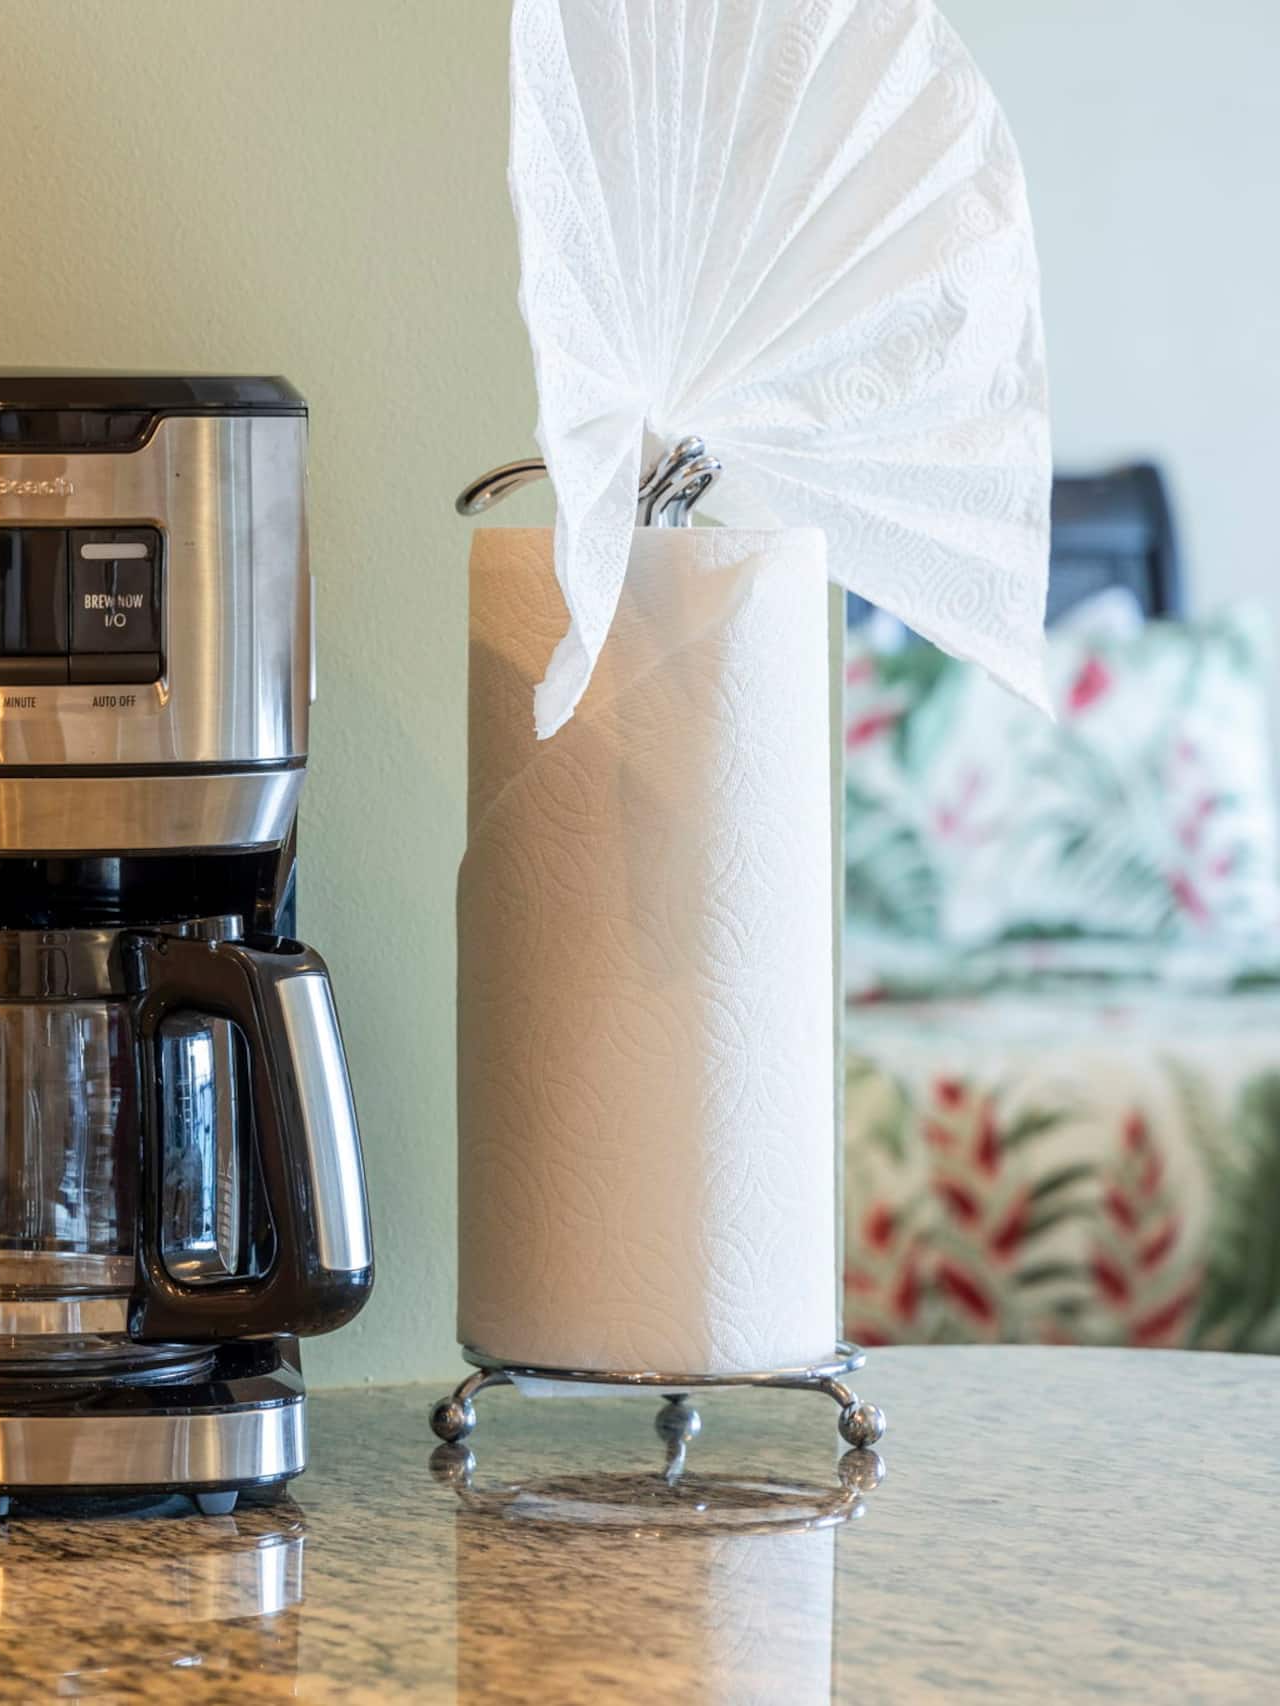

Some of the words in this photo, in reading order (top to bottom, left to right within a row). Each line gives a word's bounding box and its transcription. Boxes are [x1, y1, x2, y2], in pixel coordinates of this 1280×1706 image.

[84, 594, 114, 609] BREW
[117, 594, 143, 609] NOW
[2, 696, 37, 708] MINUTE
[92, 695, 117, 708] AUTO
[119, 694, 137, 707] OFF
